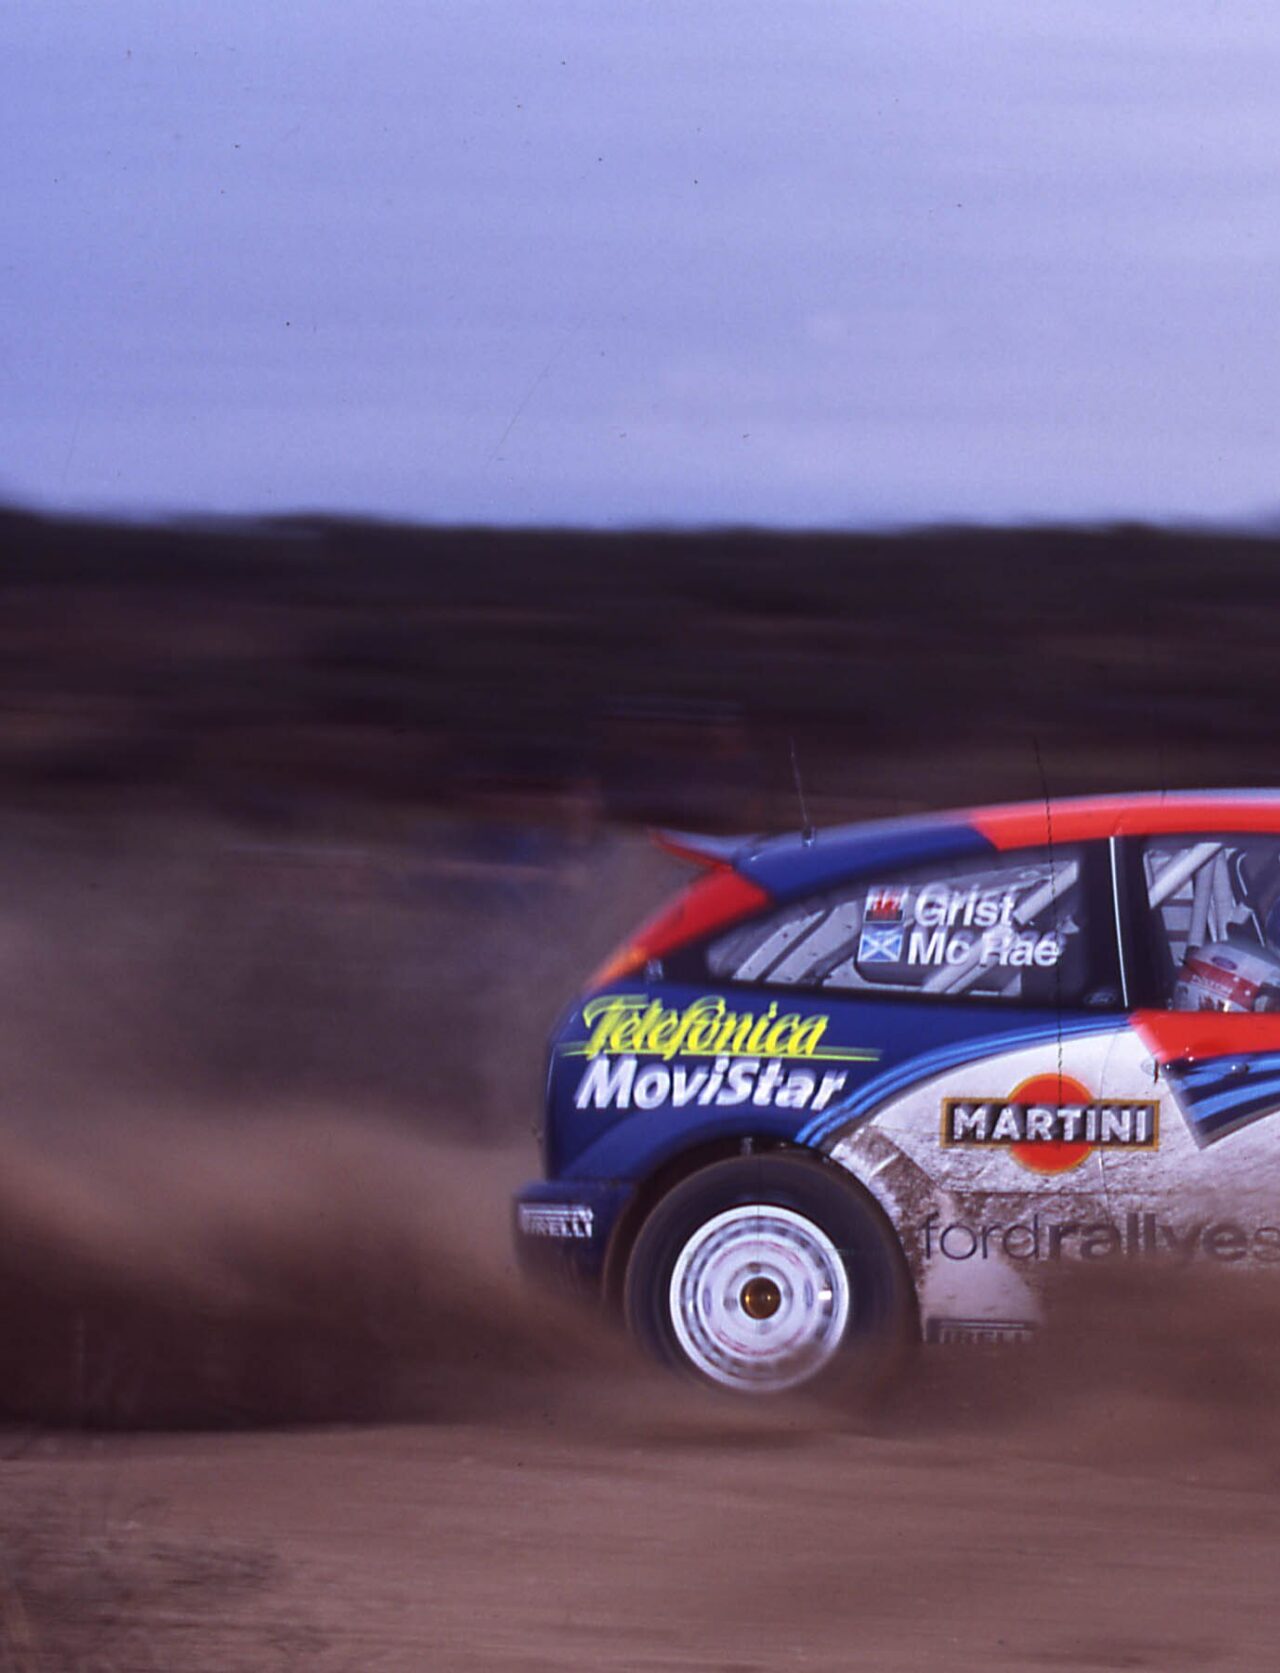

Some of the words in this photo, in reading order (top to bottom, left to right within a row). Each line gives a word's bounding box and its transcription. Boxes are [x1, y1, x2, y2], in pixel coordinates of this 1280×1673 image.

[914, 884, 1019, 927] Grist
[907, 930, 970, 966] Mc
[979, 930, 1064, 967] Rae
[575, 1054, 849, 1110] MoviStar
[952, 1106, 1147, 1142] MARTINI
